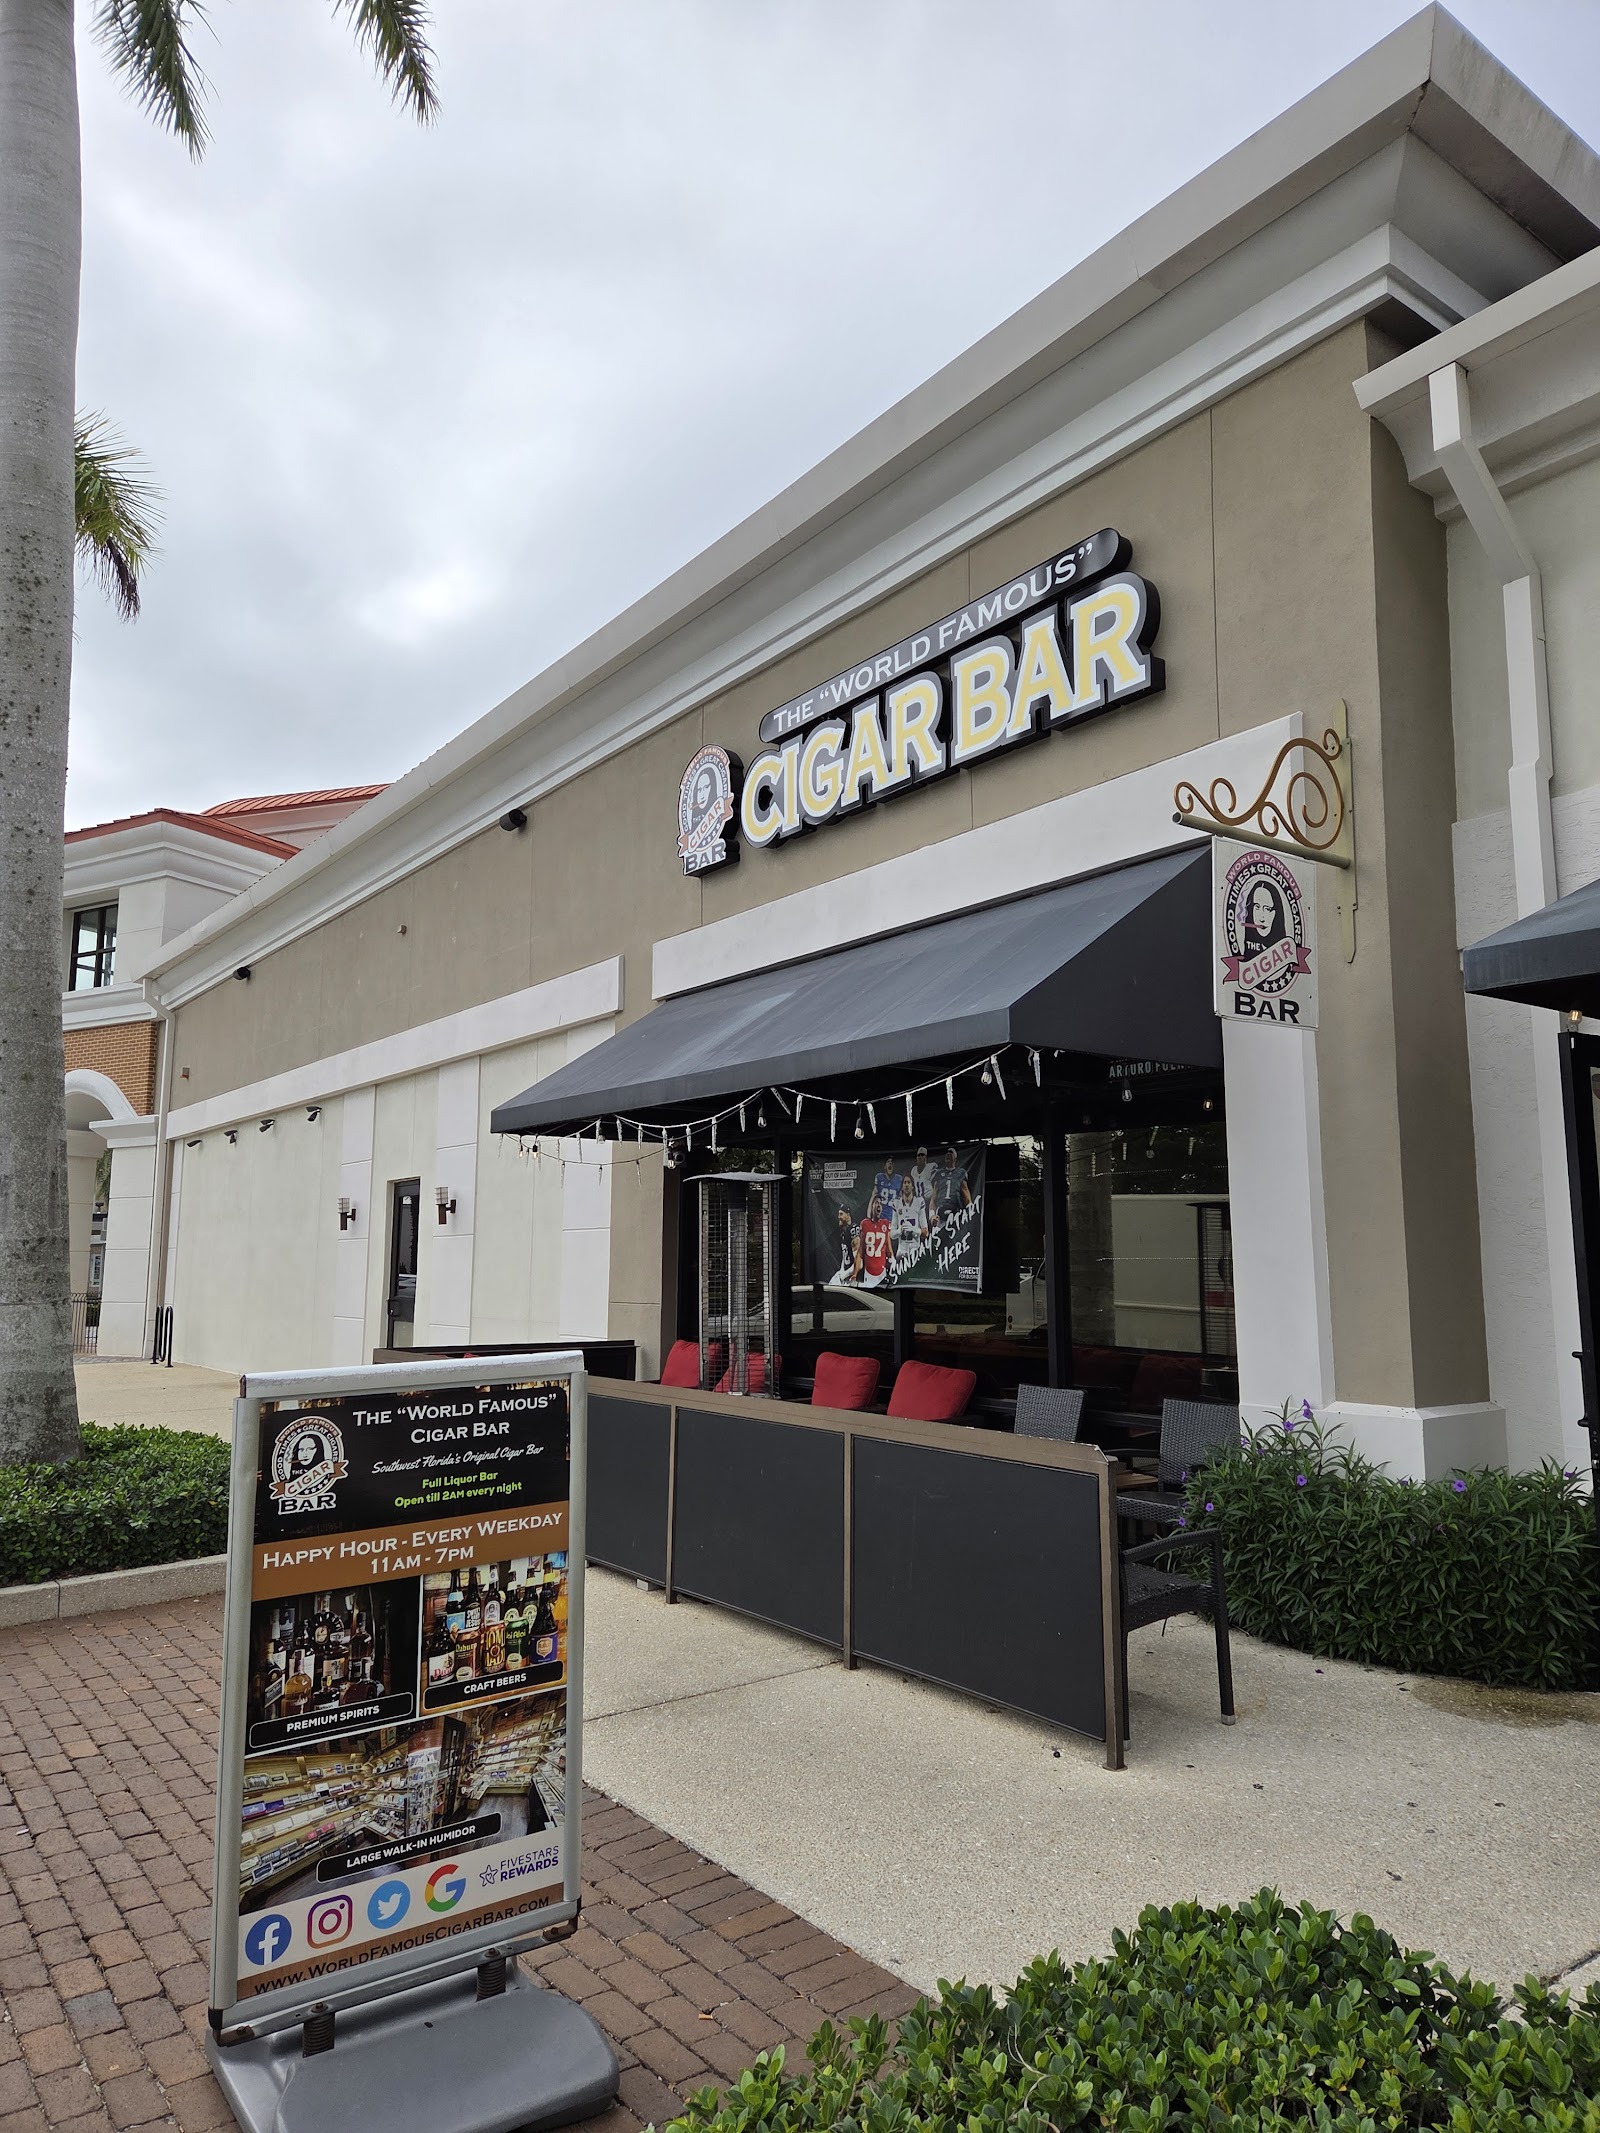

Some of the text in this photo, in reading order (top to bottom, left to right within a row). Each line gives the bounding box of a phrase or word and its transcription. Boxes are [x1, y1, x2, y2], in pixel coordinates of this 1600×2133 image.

[773, 543, 1093, 732] THE “WORLD FAMOUS”
[742, 583, 1147, 842] CIGAR BAR
[682, 747, 727, 783] WORLD FAMOUS
[684, 768, 697, 799] TIMES
[700, 755, 719, 765] GREAT
[718, 762, 728, 798] CIGARS
[689, 800, 722, 848] CIGAR
[686, 842, 725, 873] BAR
[1228, 853, 1301, 897] WORLD FAMOUS
[1227, 864, 1302, 954] GOOD TIMES GREAT CIGARS
[1246, 940, 1261, 950] THE
[1242, 940, 1294, 985] CIGAR
[1234, 991, 1300, 1024] BAR
[865, 1232, 886, 1257] 87
[889, 1195, 981, 1284] SUNDAYS START
[938, 1232, 971, 1274] HERE
[278, 1419, 338, 1442] WORLD FAMOUS
[352, 1410, 392, 1426] THE
[411, 1422, 510, 1444] CIGAR BAR
[277, 1424, 339, 1480] GOOD TIMES GREAT CIGARS
[371, 1443, 544, 1474] Southwest Florida's Original Cigar Bar
[288, 1462, 330, 1494] CIGAR
[422, 1471, 498, 1488] Full Liquor Bar
[280, 1494, 335, 1513] BAR
[394, 1481, 523, 1508] Open till 2AM every night
[262, 1547, 334, 1569] HAPPY
[339, 1537, 398, 1559] HOUR
[412, 1526, 472, 1548] EVERY
[477, 1512, 563, 1537] WEEKDAY
[435, 1545, 474, 1564] 7PM
[464, 1673, 527, 1694] CRAFT BEERS
[286, 1714, 338, 1733] PREMIUM
[339, 1705, 380, 1721] SPIRITS
[346, 1825, 476, 1868] LARGE WALK-IN HUMIDOR
[500, 1845, 560, 1871] FIVESTARS
[500, 1856, 559, 1882] REWARDS
